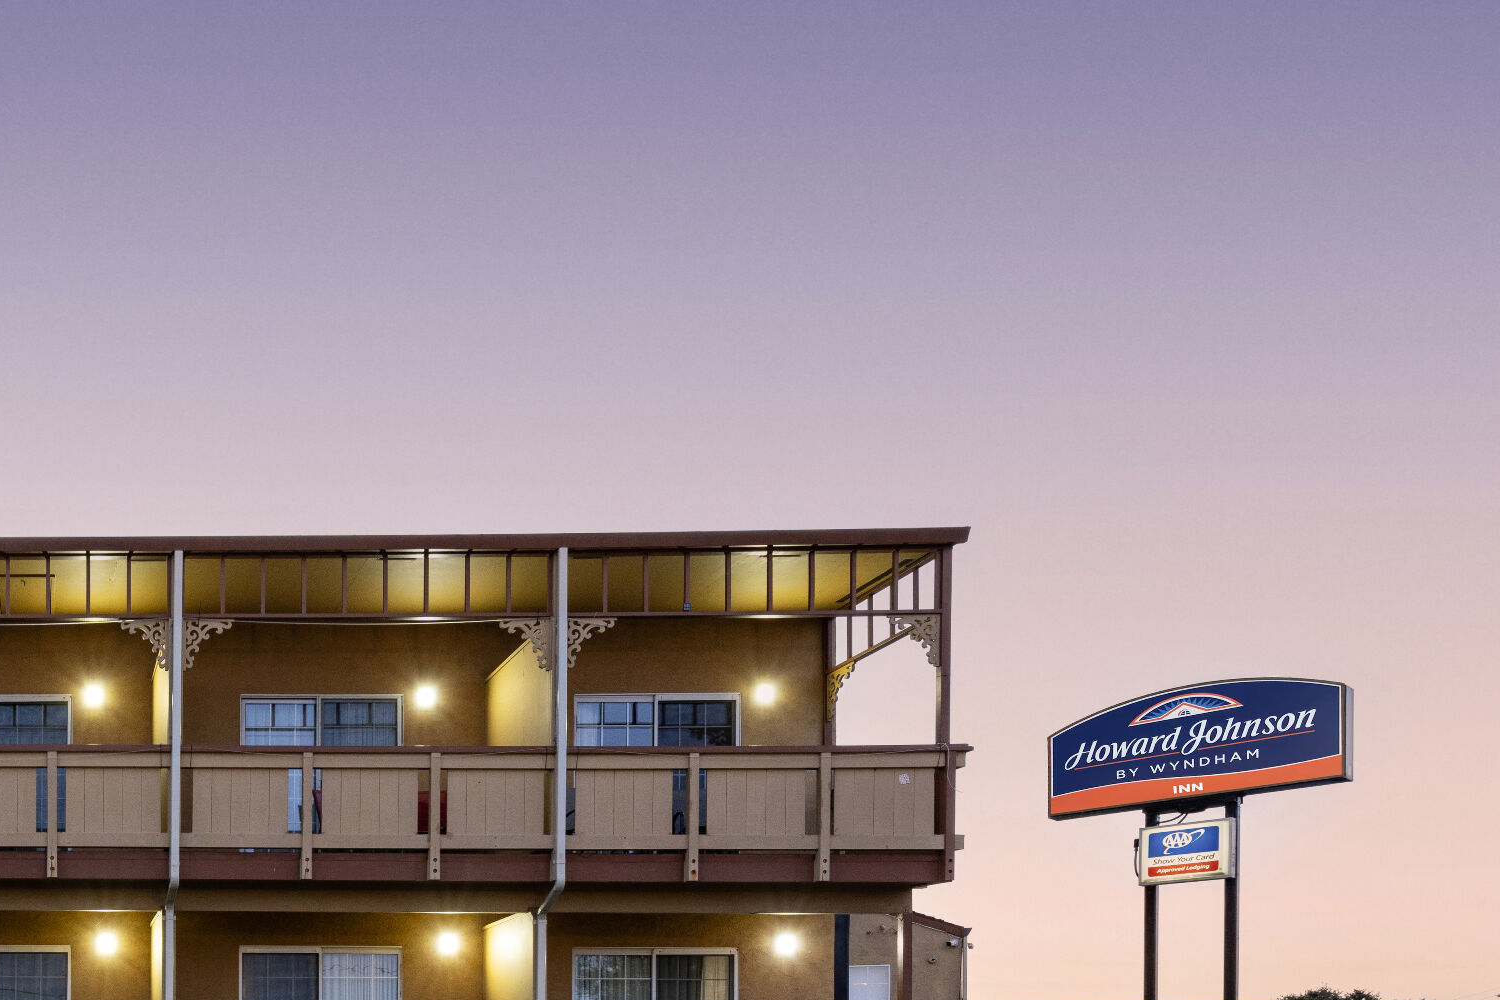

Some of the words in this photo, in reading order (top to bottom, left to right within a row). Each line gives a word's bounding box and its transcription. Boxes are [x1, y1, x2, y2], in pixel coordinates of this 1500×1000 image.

[1064, 726, 1182, 771] Howard
[1180, 707, 1317, 756] Johnson
[1116, 766, 1140, 780] BY
[1150, 748, 1261, 775] WYNDHAM
[1172, 782, 1204, 795] INN
[1164, 832, 1191, 848] AAA
[1153, 858, 1175, 866] Show
[1196, 853, 1215, 861] Card
[1186, 864, 1210, 872] Lodging
